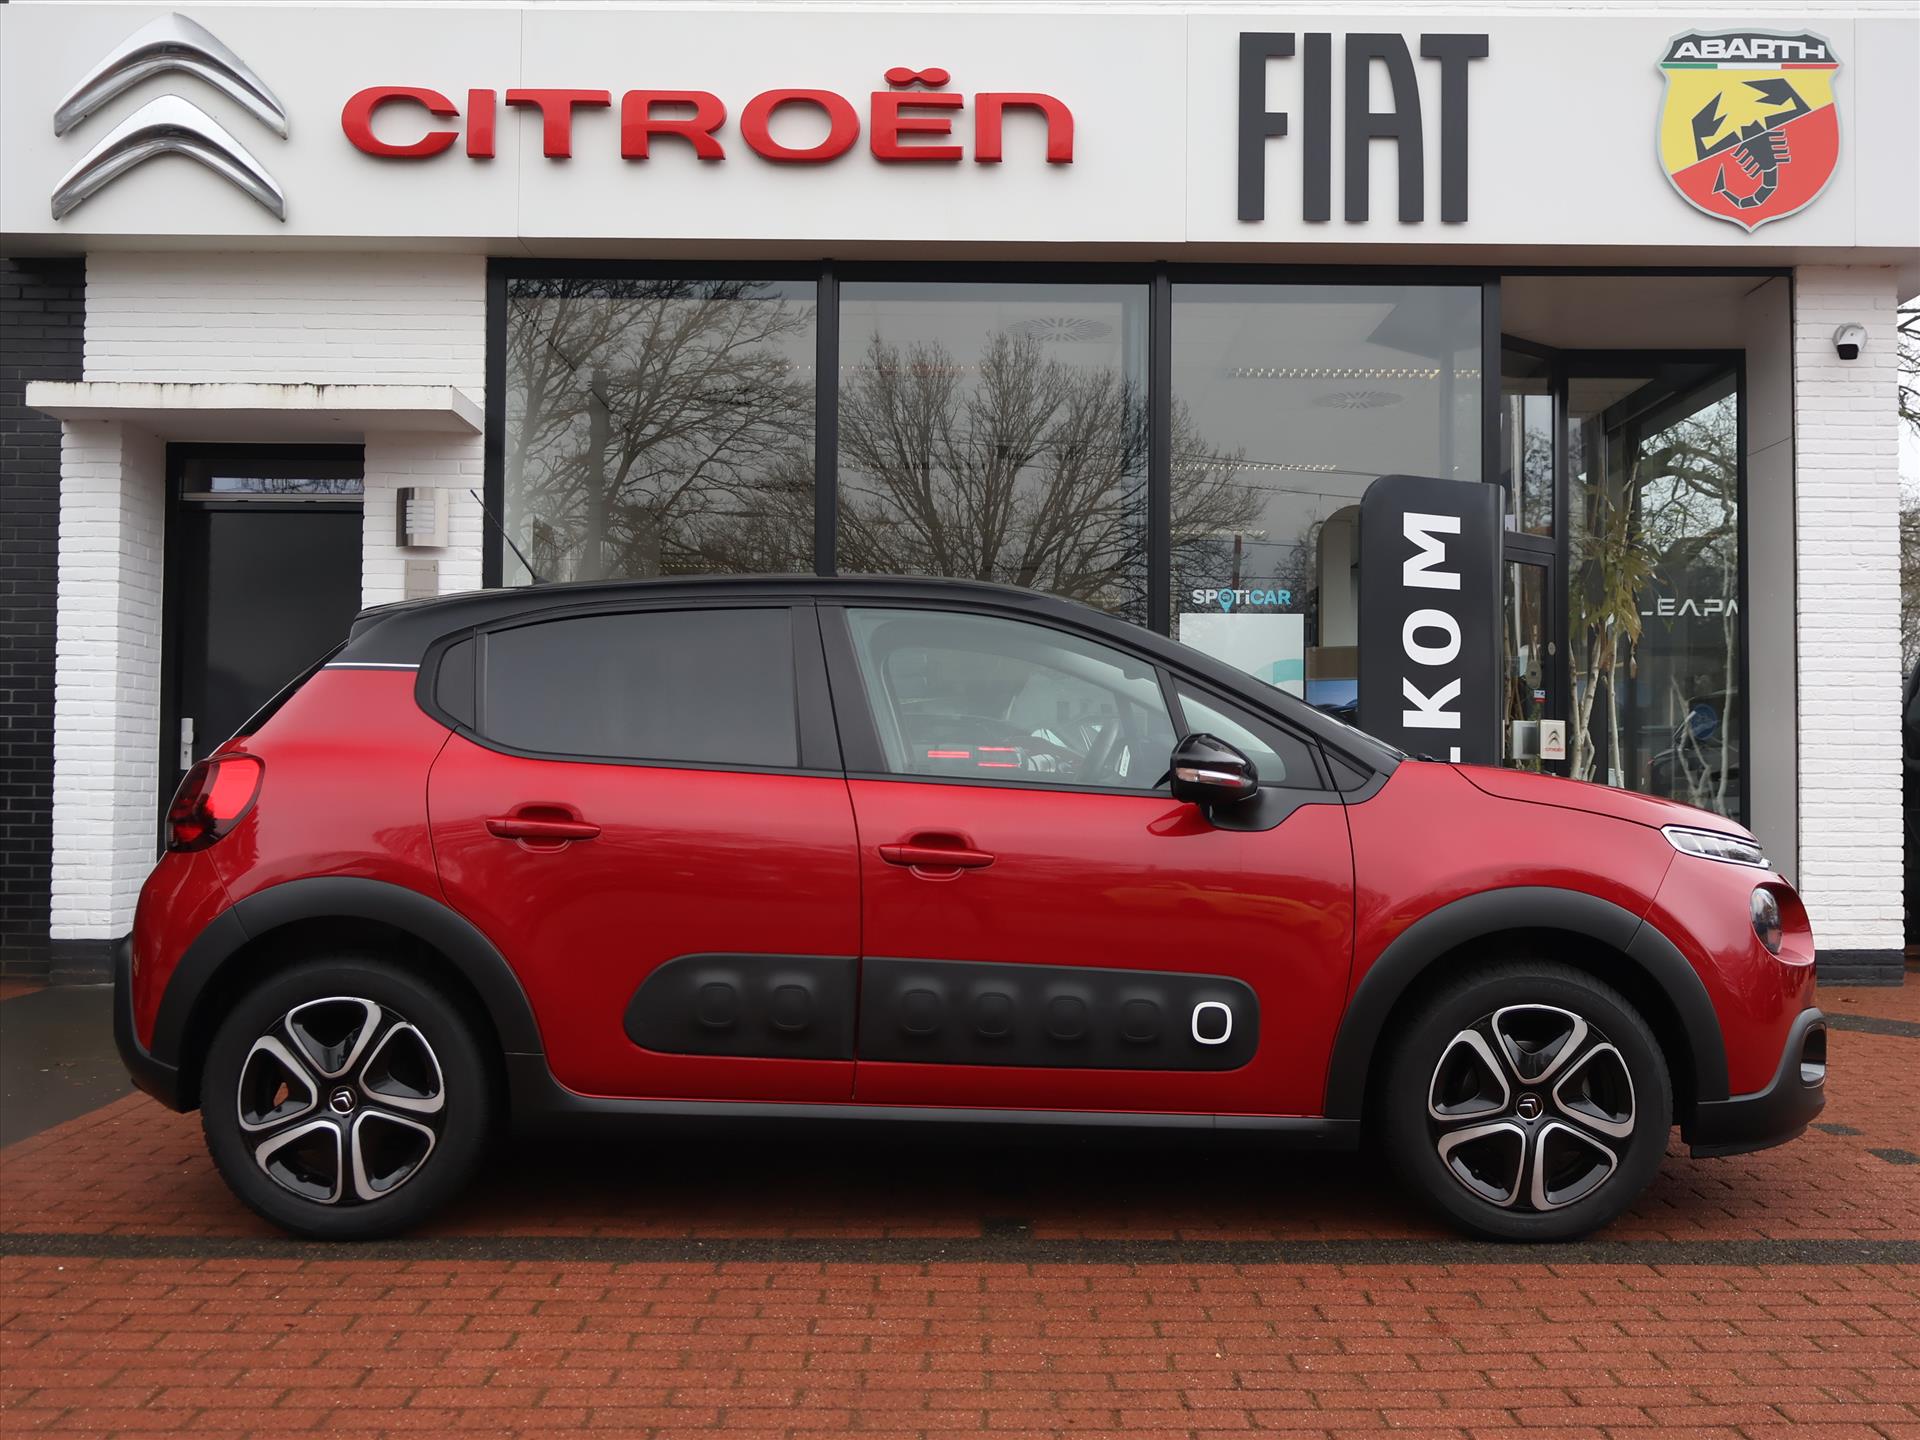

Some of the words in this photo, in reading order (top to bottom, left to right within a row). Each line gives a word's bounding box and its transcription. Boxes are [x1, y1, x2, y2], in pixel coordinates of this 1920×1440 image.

[1238, 31, 1489, 222] FIAT
[1672, 37, 1826, 60] ABARTH
[1402, 511, 1462, 763] KOM
